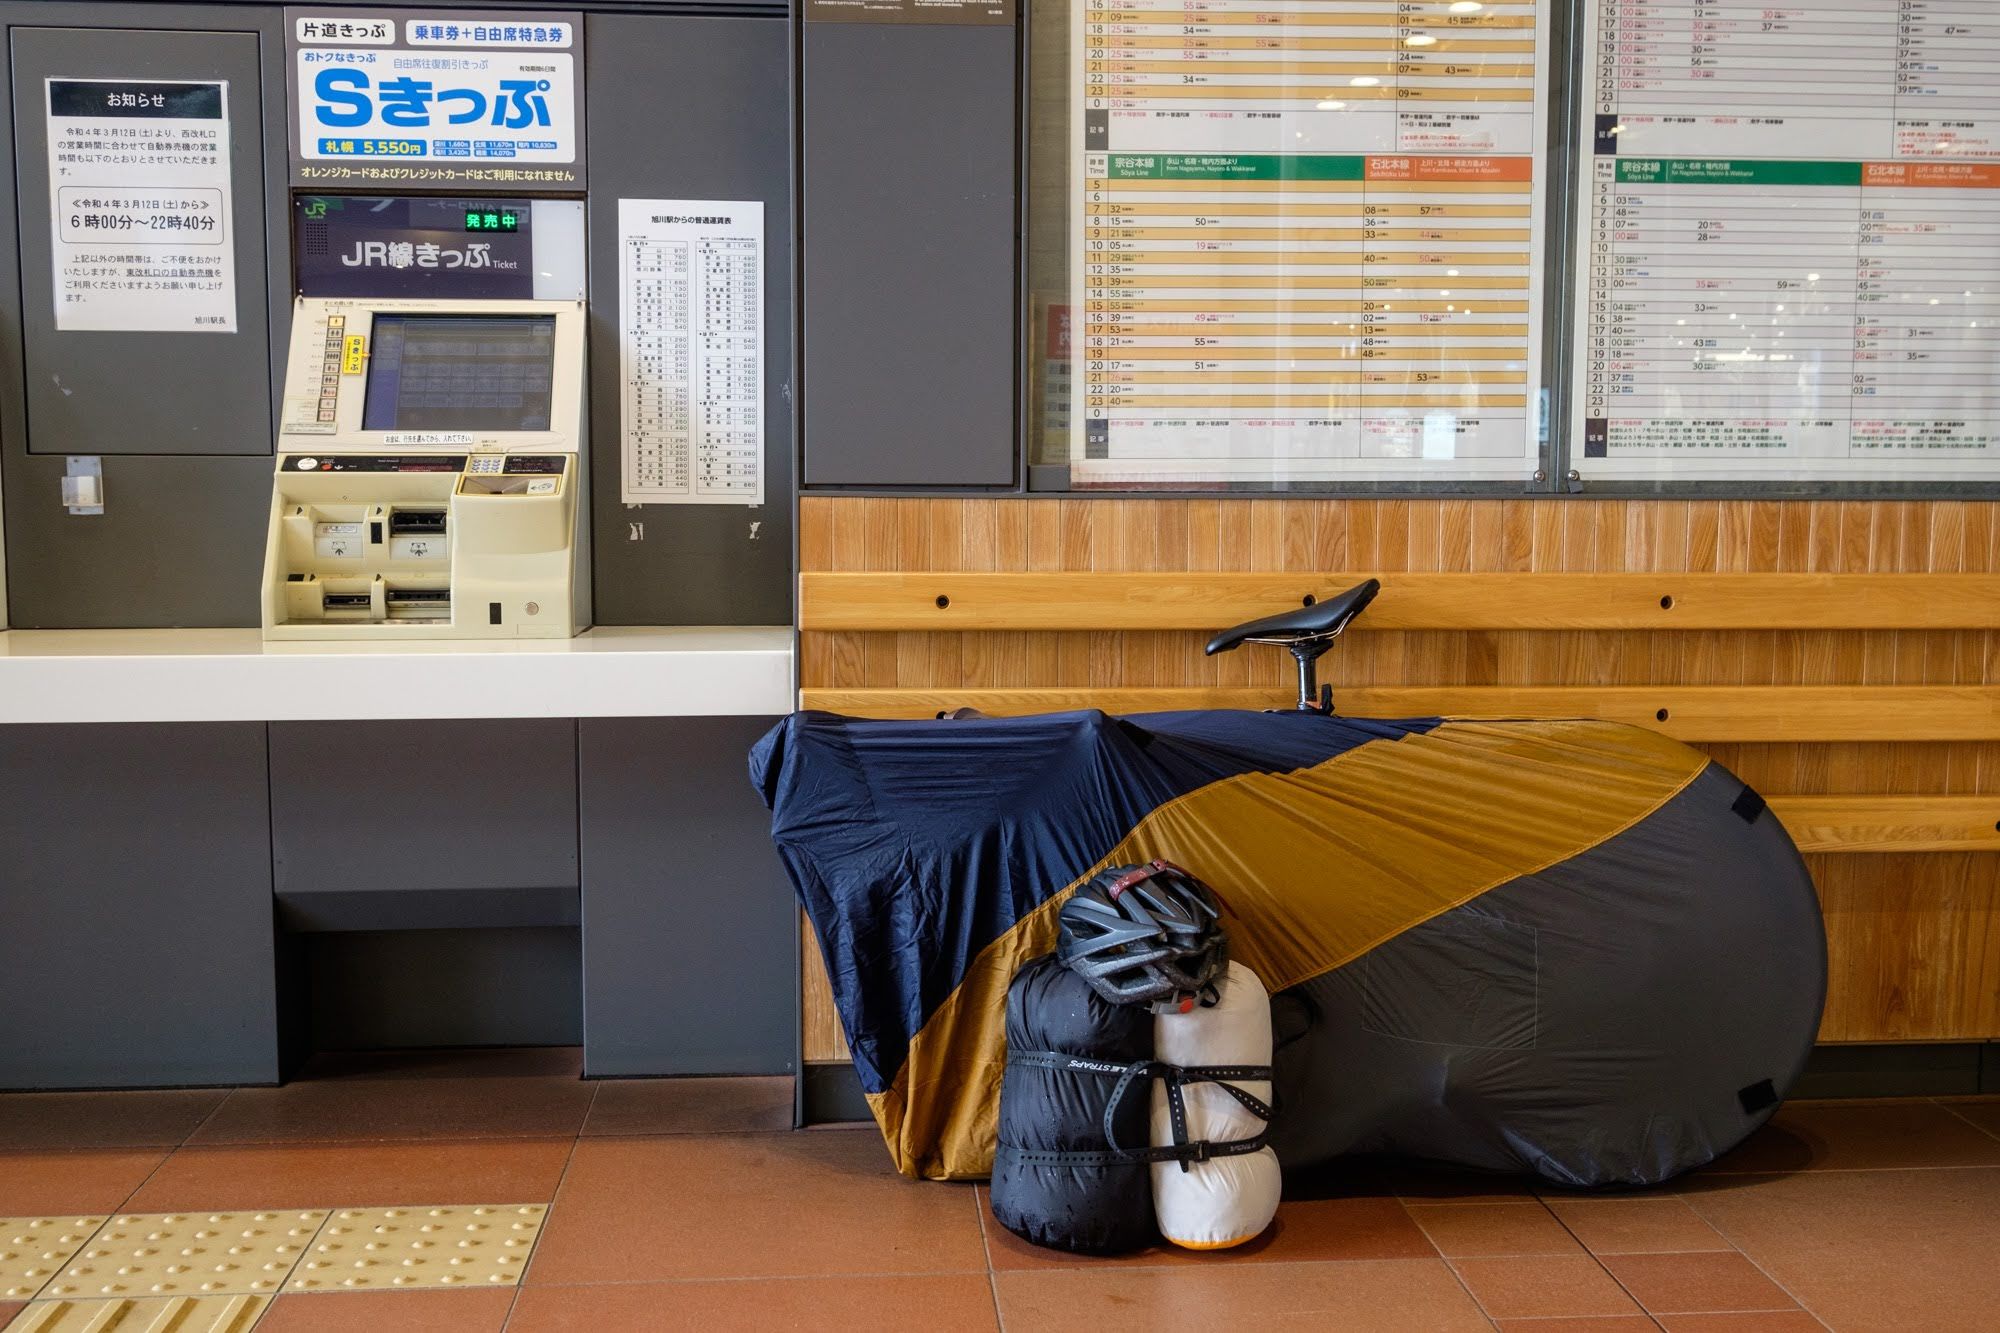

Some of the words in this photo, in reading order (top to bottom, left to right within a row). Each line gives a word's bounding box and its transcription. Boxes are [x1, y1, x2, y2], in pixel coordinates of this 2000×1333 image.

[1400, 4, 1410, 12] 04
[1093, 13, 1103, 21] 17
[1111, 13, 1121, 21] 09
[1606, 8, 1615, 16] 16
[1623, 8, 1633, 16] 00
[1695, 9, 1703, 17] 12
[1763, 11, 1773, 19] 30
[1400, 16, 1408, 24] 01
[1606, 19, 1615, 28] 17
[1623, 20, 1633, 28] 00
[1762, 23, 1772, 31] 37
[303, 23, 386, 38] 片道きっぷ
[415, 26, 563, 42] 乗車券+自由席特急券
[1093, 37, 1103, 46] 19
[1605, 44, 1614, 52] 19
[304, 53, 376, 63] おトクなきっぷ
[1092, 49, 1103, 58] 20
[1111, 50, 1121, 58] 25
[1184, 51, 1194, 59] 55
[393, 59, 488, 70] 自由席往復割引きっぷ
[1603, 56, 1614, 64] 20
[1399, 65, 1409, 73] 07
[1445, 66, 1455, 74] 43
[1092, 74, 1103, 83] 22
[107, 93, 165, 107] お知らせ
[315, 68, 552, 129] Sきっぷ
[58, 141, 217, 151] の営業時間に合わせて自動券売機の営業
[326, 141, 354, 153] 札幌
[364, 142, 421, 155] 5,550円
[58, 154, 217, 164] 時間も以下のとおりとさせていただきま
[1115, 158, 1154, 169] 宗谷本線
[1372, 159, 1409, 170] 石北本線
[1622, 161, 1660, 173] 宗谷本線
[59, 168, 71, 176] す。
[301, 167, 574, 181] オレンジカードおよびクレジットカードはご利用になれません
[1094, 180, 1100, 189] 5
[1601, 196, 1606, 204] 6
[305, 203, 326, 215] JR
[1094, 205, 1100, 213] 7
[1111, 205, 1120, 213] 32
[466, 214, 517, 228] 発売中
[652, 216, 732, 224] 旭川駅からの普通運賃表
[1094, 217, 1099, 225] 8
[1112, 217, 1120, 225] 15
[1600, 220, 1606, 228] 8
[1616, 220, 1626, 228] 07
[1698, 221, 1708, 229] 20
[1094, 229, 1100, 237] 9
[1111, 229, 1119, 237] 21
[1600, 232, 1605, 240] 9
[1698, 233, 1707, 241] 28
[1092, 241, 1102, 249] 10
[342, 242, 490, 268] JR線きっぷ
[493, 260, 517, 269] Ticket
[1092, 265, 1102, 274] 12
[65, 281, 222, 290] ご利用くださいますようお願い申し上げ
[1597, 279, 1606, 287] 13
[66, 294, 86, 302] ます。
[1092, 314, 1102, 322] 16
[1363, 314, 1373, 322] 02
[1596, 315, 1605, 323] 16
[1365, 326, 1373, 334] 13
[1595, 338, 1604, 346] 18
[1694, 339, 1703, 347] 43
[351, 339, 360, 371] Sきっぷ
[1908, 352, 1917, 360] 35
[1091, 361, 1103, 369] 20
[1593, 362, 1604, 370] 20
[1611, 362, 1621, 370] 06
[1417, 373, 1427, 381] 53
[1091, 385, 1103, 393] 22
[1592, 385, 1603, 393] 22
[1611, 385, 1620, 393] 32
